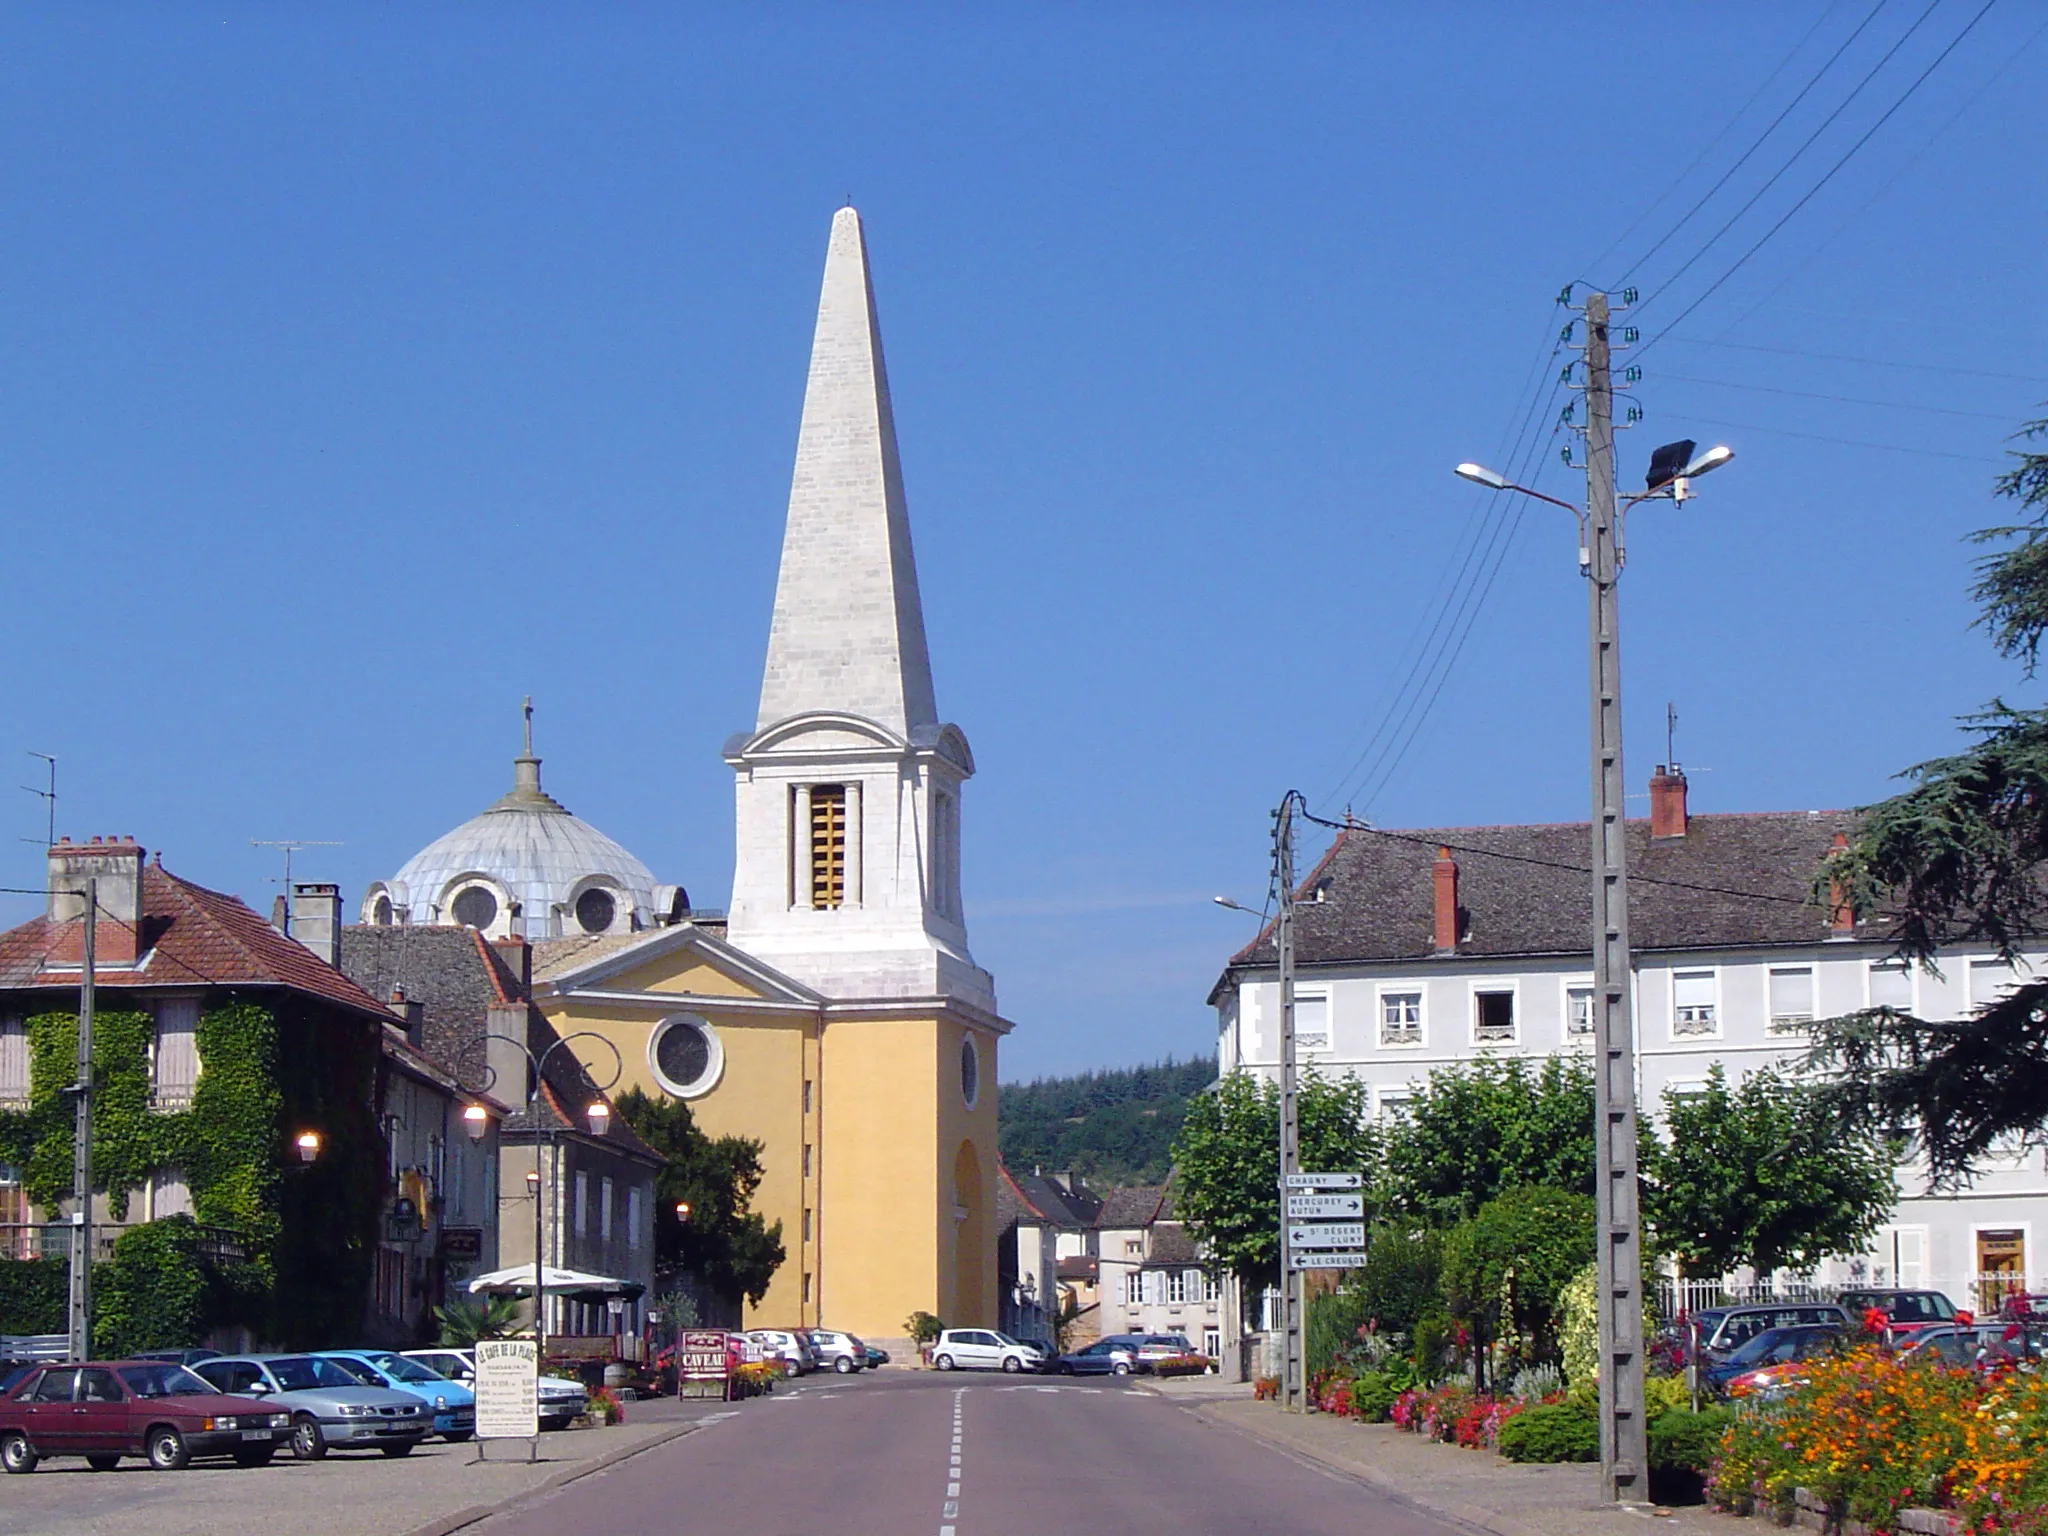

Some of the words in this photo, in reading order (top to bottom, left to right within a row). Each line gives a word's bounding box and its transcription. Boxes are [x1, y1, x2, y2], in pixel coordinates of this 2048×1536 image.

[1288, 1177, 1328, 1185] CHAGNY
[1290, 1207, 1322, 1215] AUTUN
[1324, 1226, 1362, 1235] DÉSERT
[1311, 1257, 1322, 1265] LE
[477, 1350, 486, 1364] LE
[501, 1344, 508, 1356] DE
[510, 1344, 517, 1357] LA
[683, 1354, 726, 1366] CAVEAU
